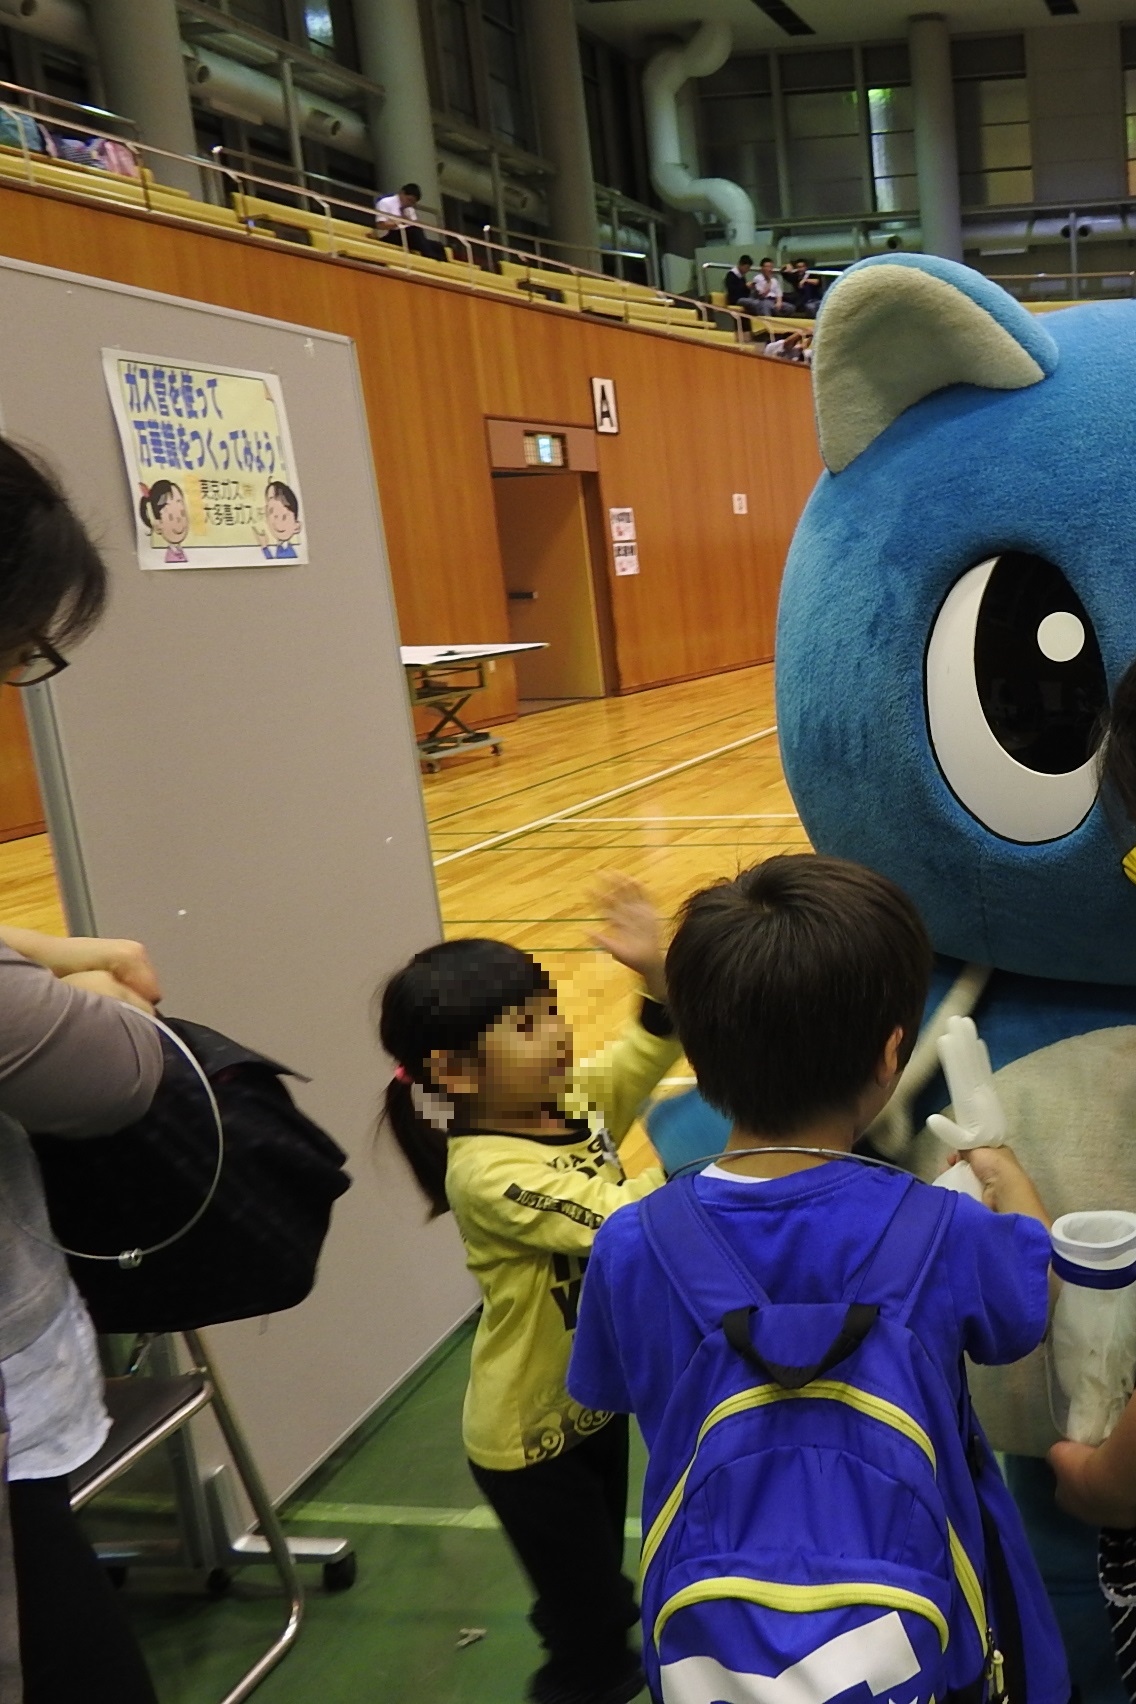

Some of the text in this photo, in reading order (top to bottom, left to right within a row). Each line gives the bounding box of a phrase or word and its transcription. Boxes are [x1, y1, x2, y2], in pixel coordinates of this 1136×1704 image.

[125, 363, 223, 419] ガス管を使って
[599, 384, 615, 428] A
